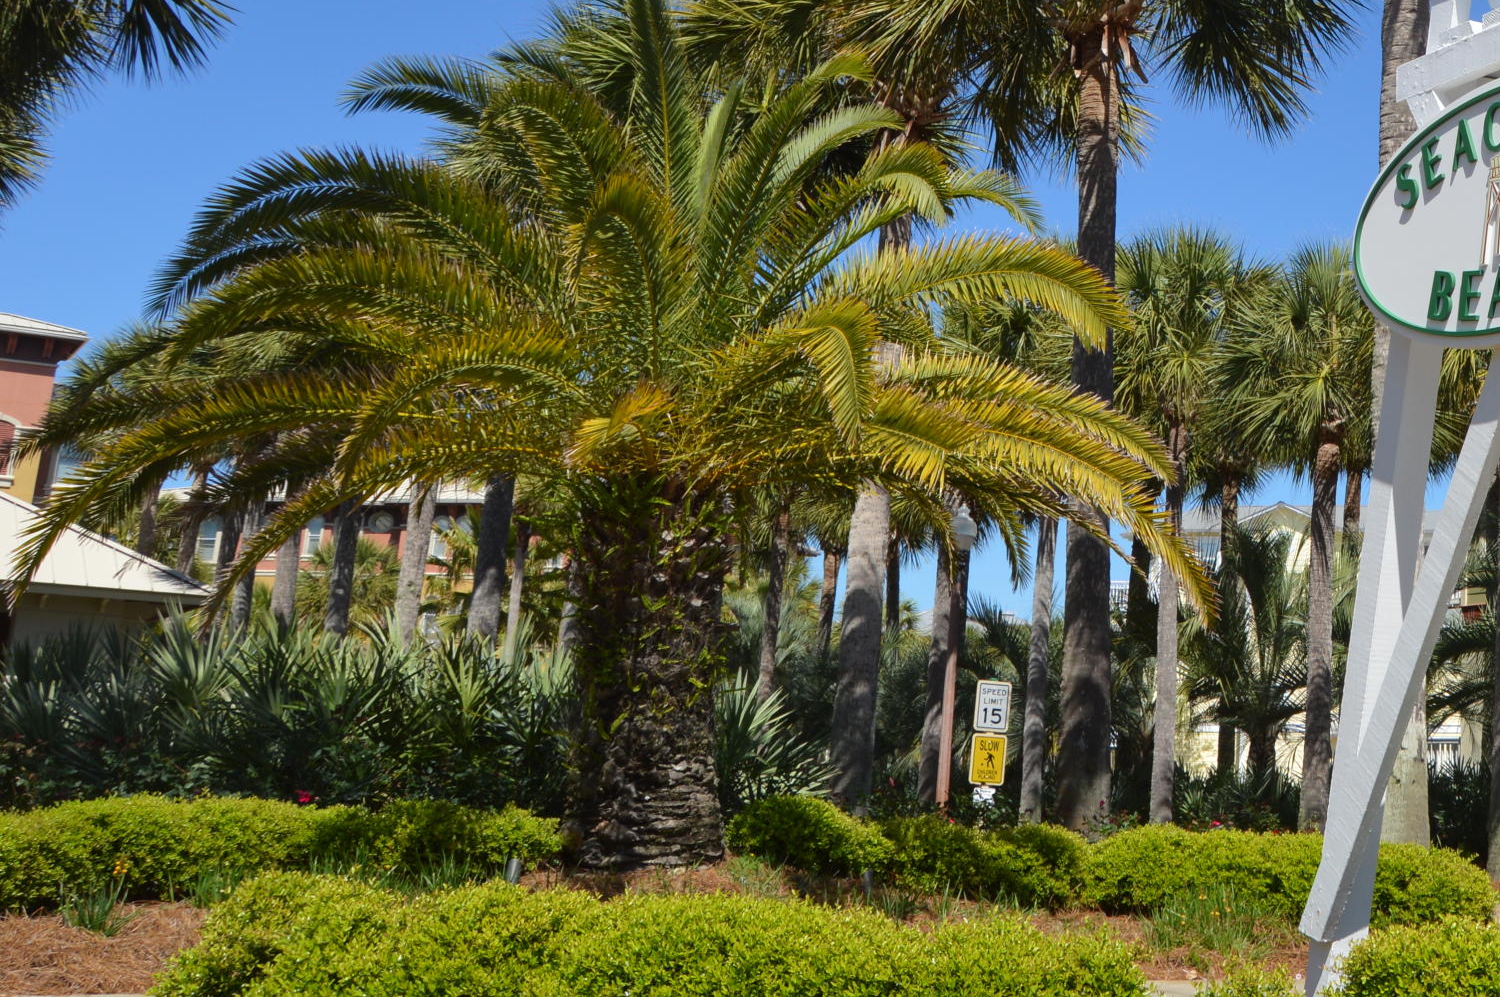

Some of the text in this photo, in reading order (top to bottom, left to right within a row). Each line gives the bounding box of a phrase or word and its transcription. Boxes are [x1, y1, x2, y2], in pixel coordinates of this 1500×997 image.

[982, 688, 1006, 696] SPEED
[983, 697, 1003, 706] LIMIT
[983, 707, 1002, 725] 15
[980, 740, 1000, 751] SLOW
